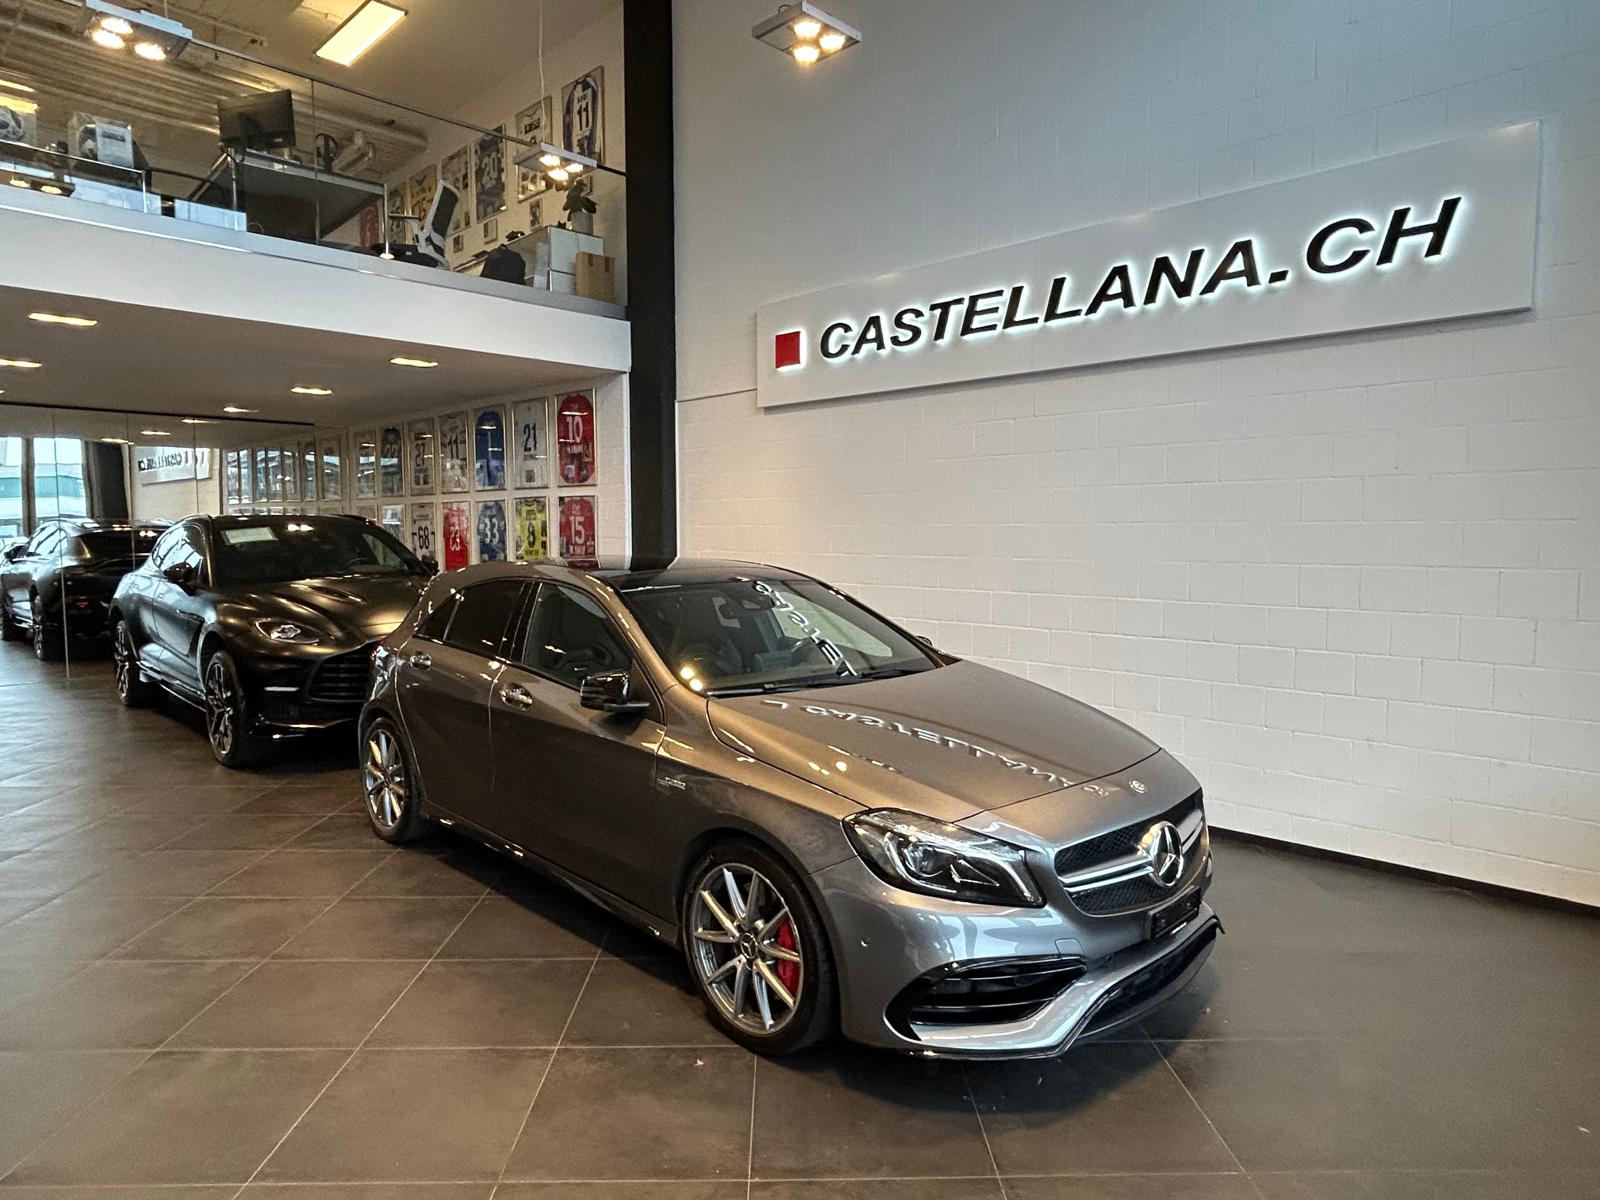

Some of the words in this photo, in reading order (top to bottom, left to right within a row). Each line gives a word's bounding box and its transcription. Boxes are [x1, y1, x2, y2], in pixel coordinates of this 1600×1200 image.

[576, 101, 589, 131] 11
[481, 152, 499, 189] 20
[820, 197, 1462, 360] CASTELLANA.CH
[523, 422, 537, 452] 21
[566, 415, 583, 444] 10
[415, 442, 425, 467] 27
[418, 525, 430, 550] 68
[484, 517, 500, 545] 33
[570, 515, 585, 545] 15
